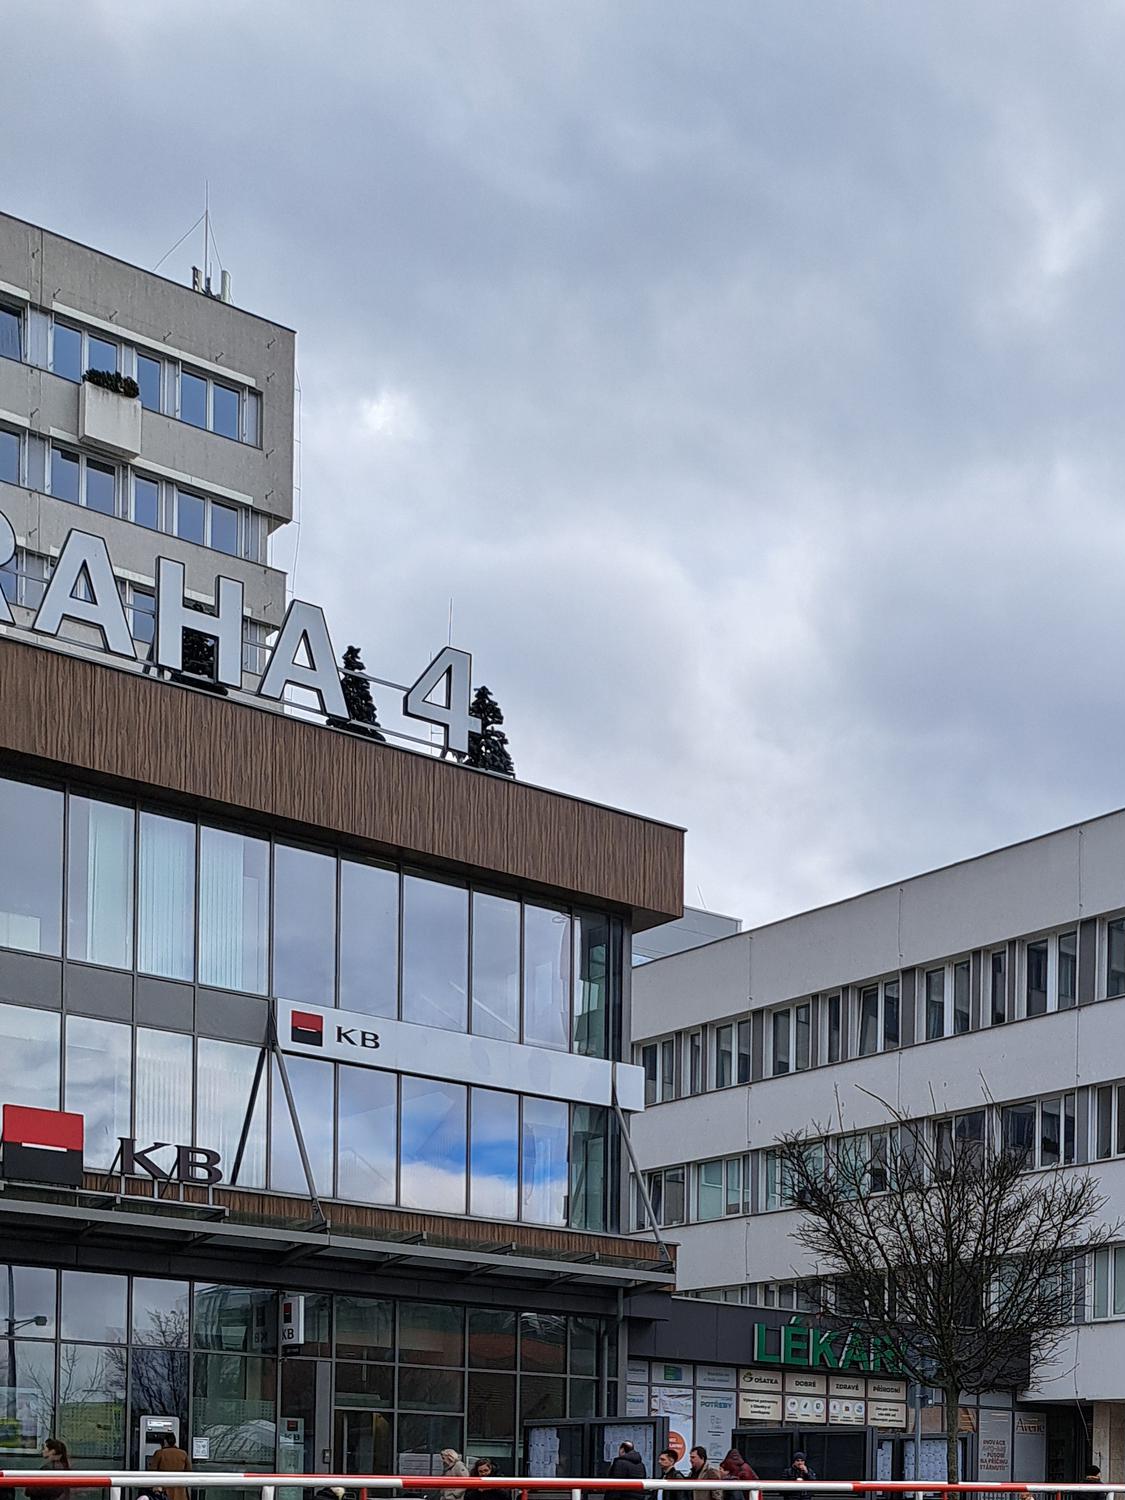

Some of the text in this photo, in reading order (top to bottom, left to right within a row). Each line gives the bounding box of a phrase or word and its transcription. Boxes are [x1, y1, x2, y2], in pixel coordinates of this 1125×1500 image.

[0, 511, 481, 759] AHA 4
[335, 1025, 380, 1049] KB
[119, 1137, 222, 1185] KB
[754, 1316, 908, 1374] LÉKÁR
[754, 1376, 779, 1385] OŠATKA
[795, 1379, 817, 1388] DOBRÉ
[835, 1382, 860, 1391] ZDRAVÉ
